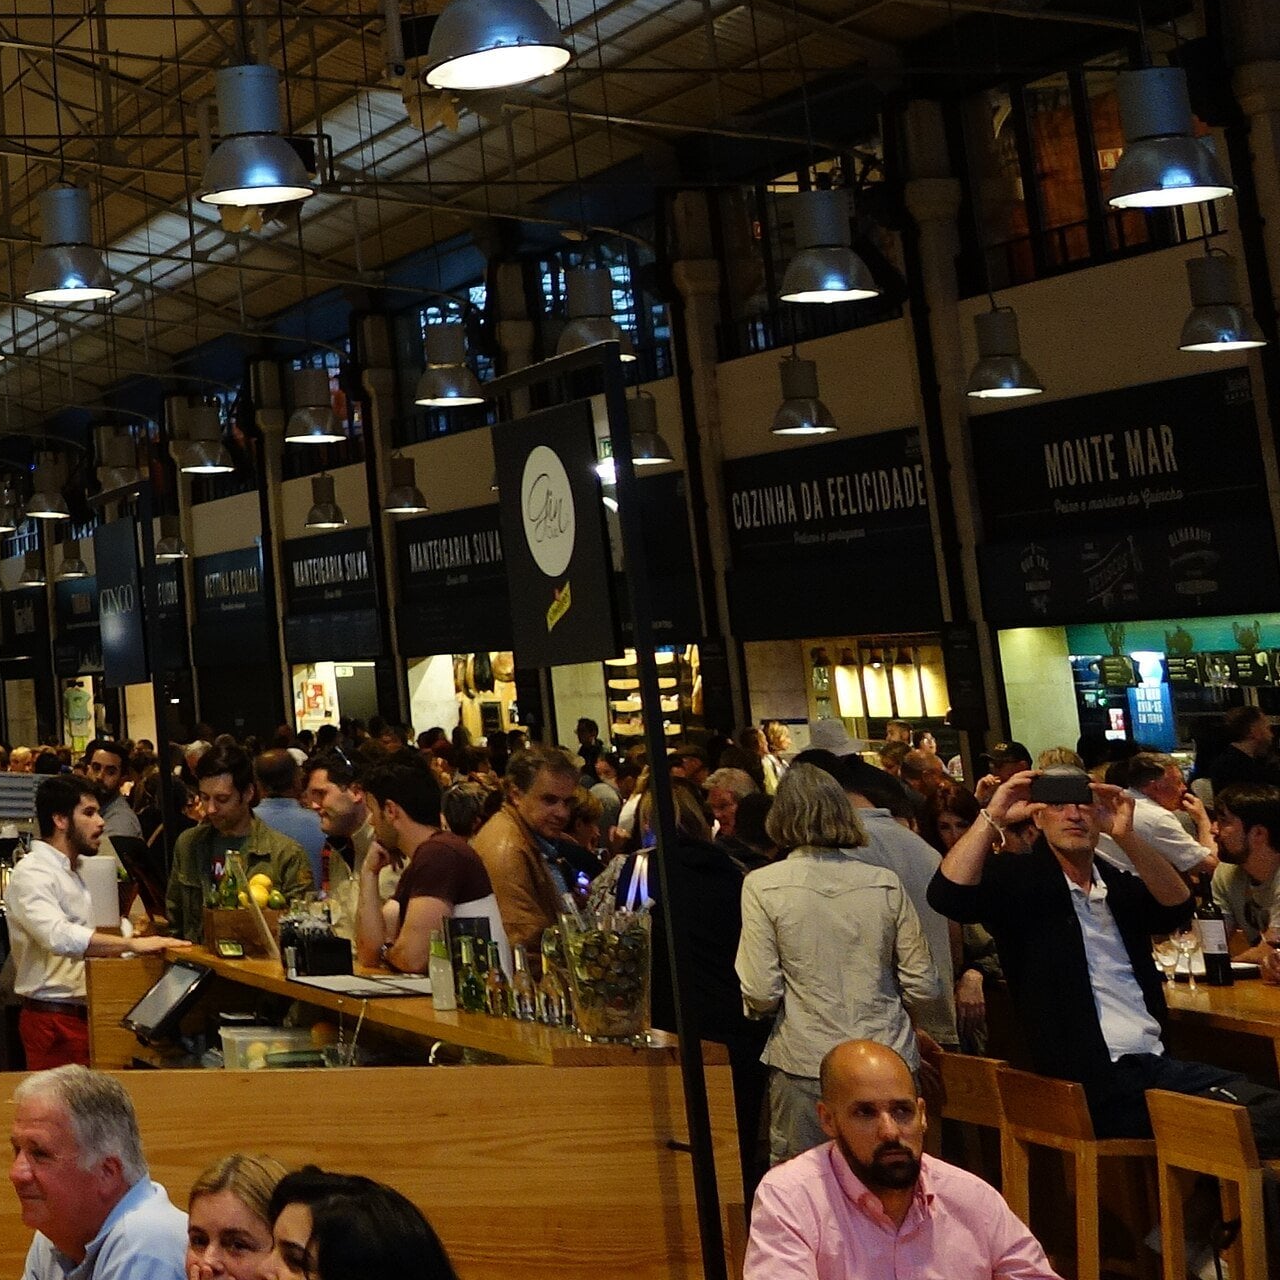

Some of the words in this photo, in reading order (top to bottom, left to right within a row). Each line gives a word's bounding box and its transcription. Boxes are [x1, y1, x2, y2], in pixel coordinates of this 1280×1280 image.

[1042, 432, 1120, 489] MONTE
[1124, 423, 1180, 478] MAR
[731, 484, 798, 531] COZINHA
[799, 479, 825, 522] DA
[826, 463, 928, 518] FELICIDADE
[408, 533, 473, 574] MANTEIGARIA
[473, 528, 504, 565] SILVA
